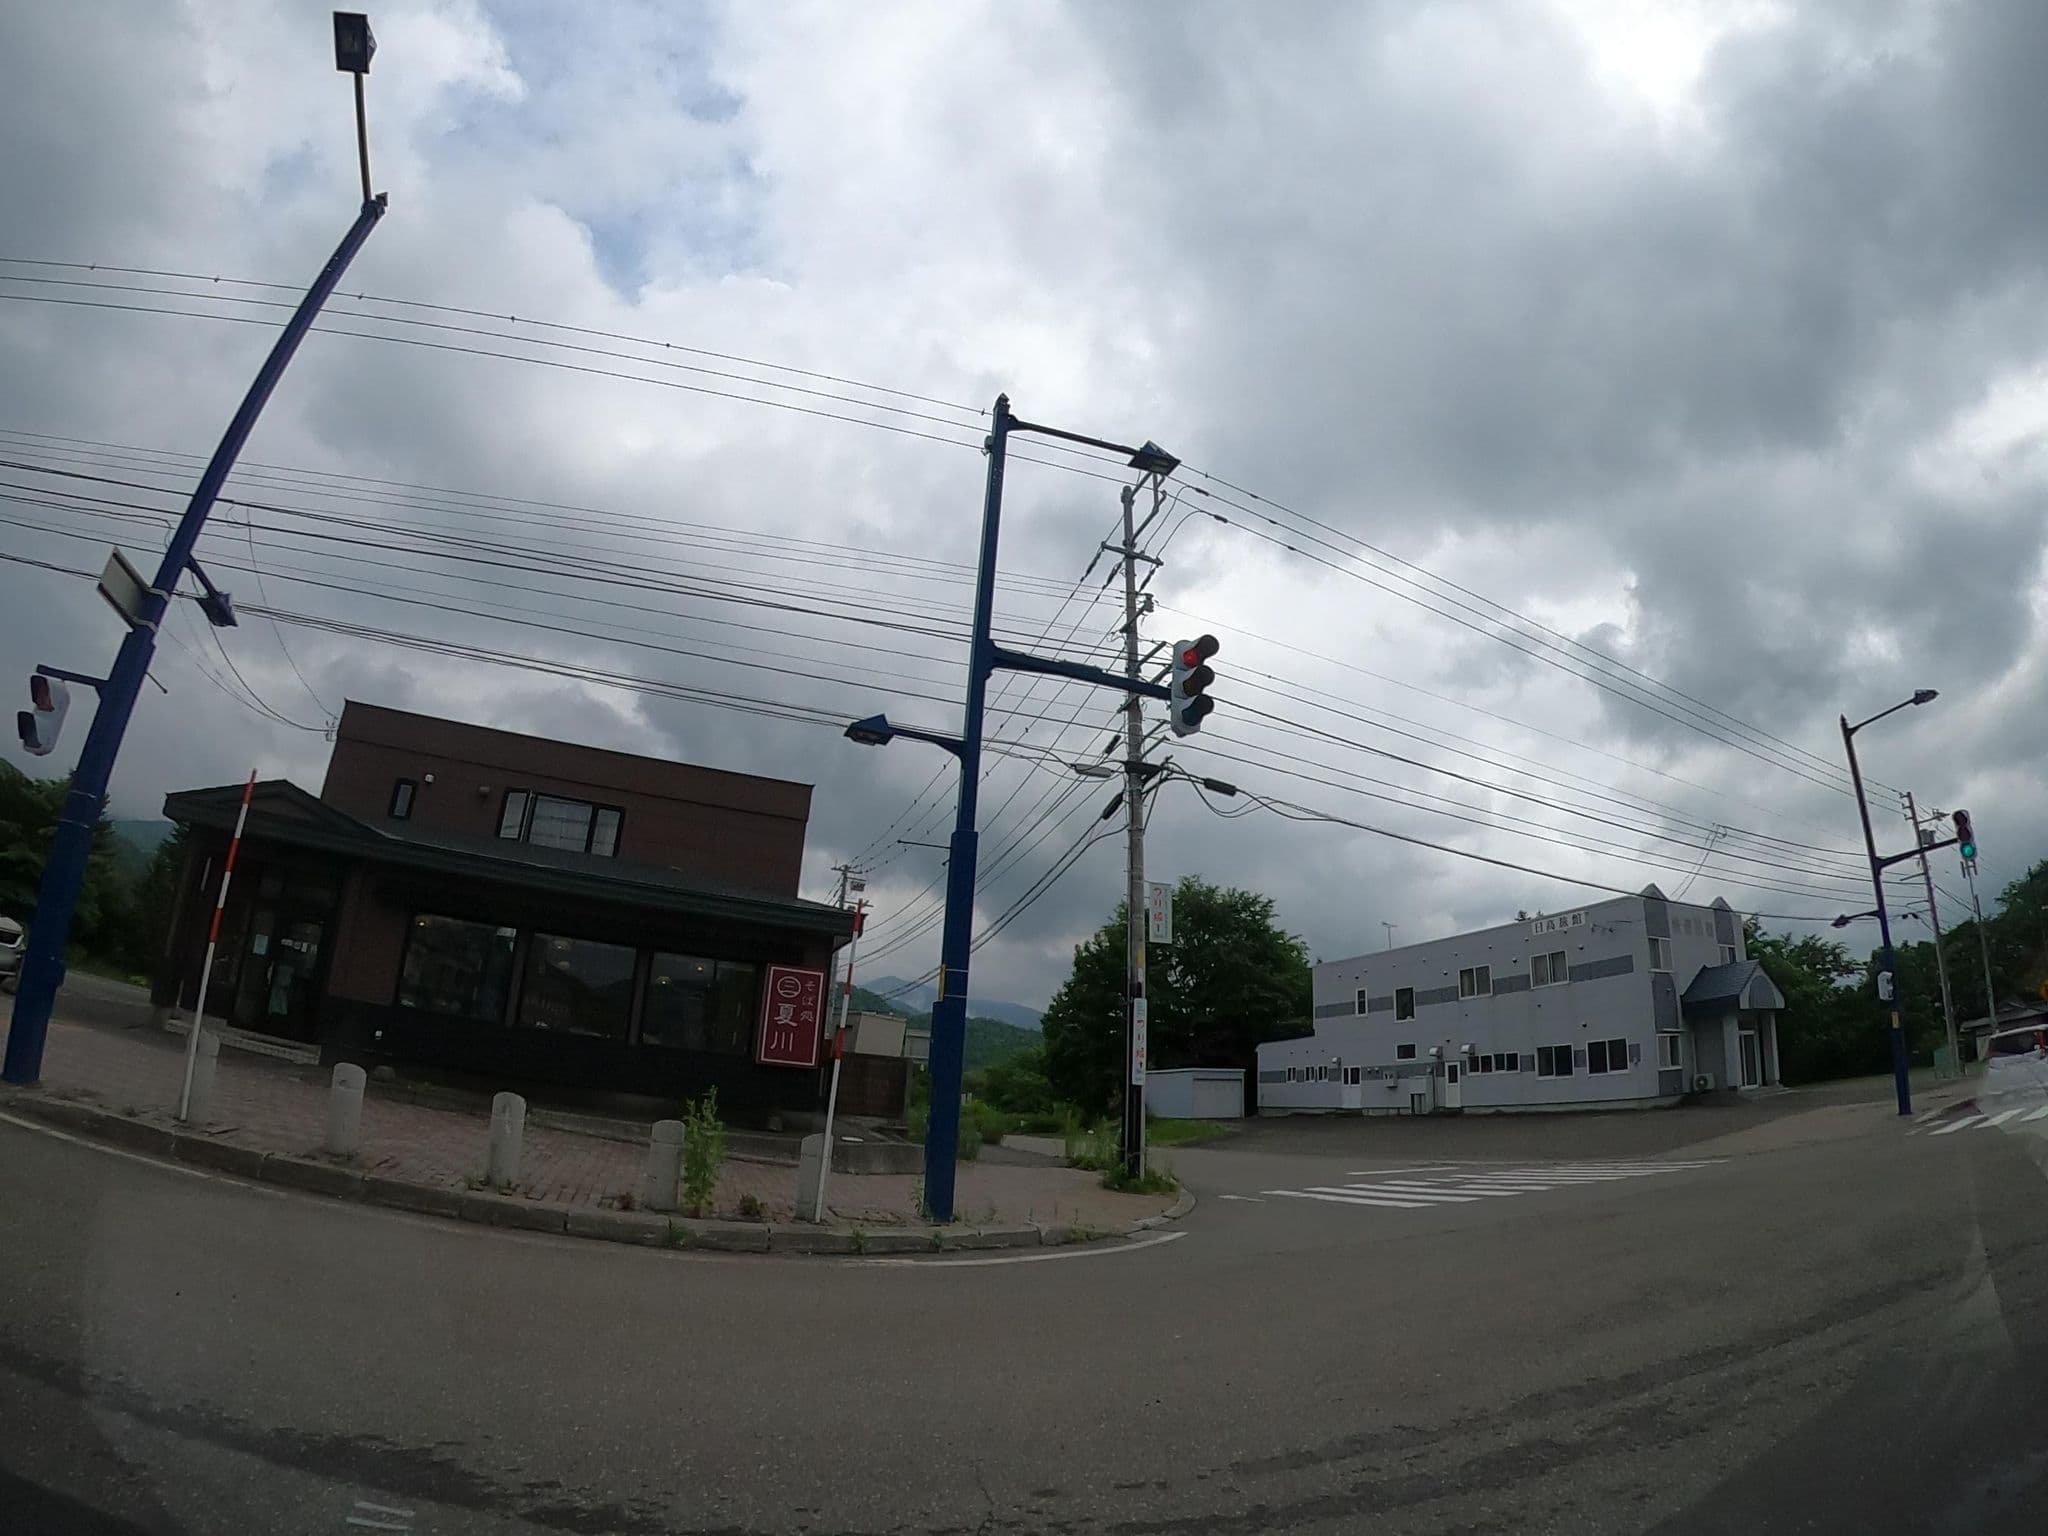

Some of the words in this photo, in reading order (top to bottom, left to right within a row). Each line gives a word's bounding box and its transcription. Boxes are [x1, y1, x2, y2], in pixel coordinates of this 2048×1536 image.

[1534, 912, 1583, 934] 日高旅館
[800, 980, 816, 1023] そば処
[769, 1003, 798, 1052] 夏川
